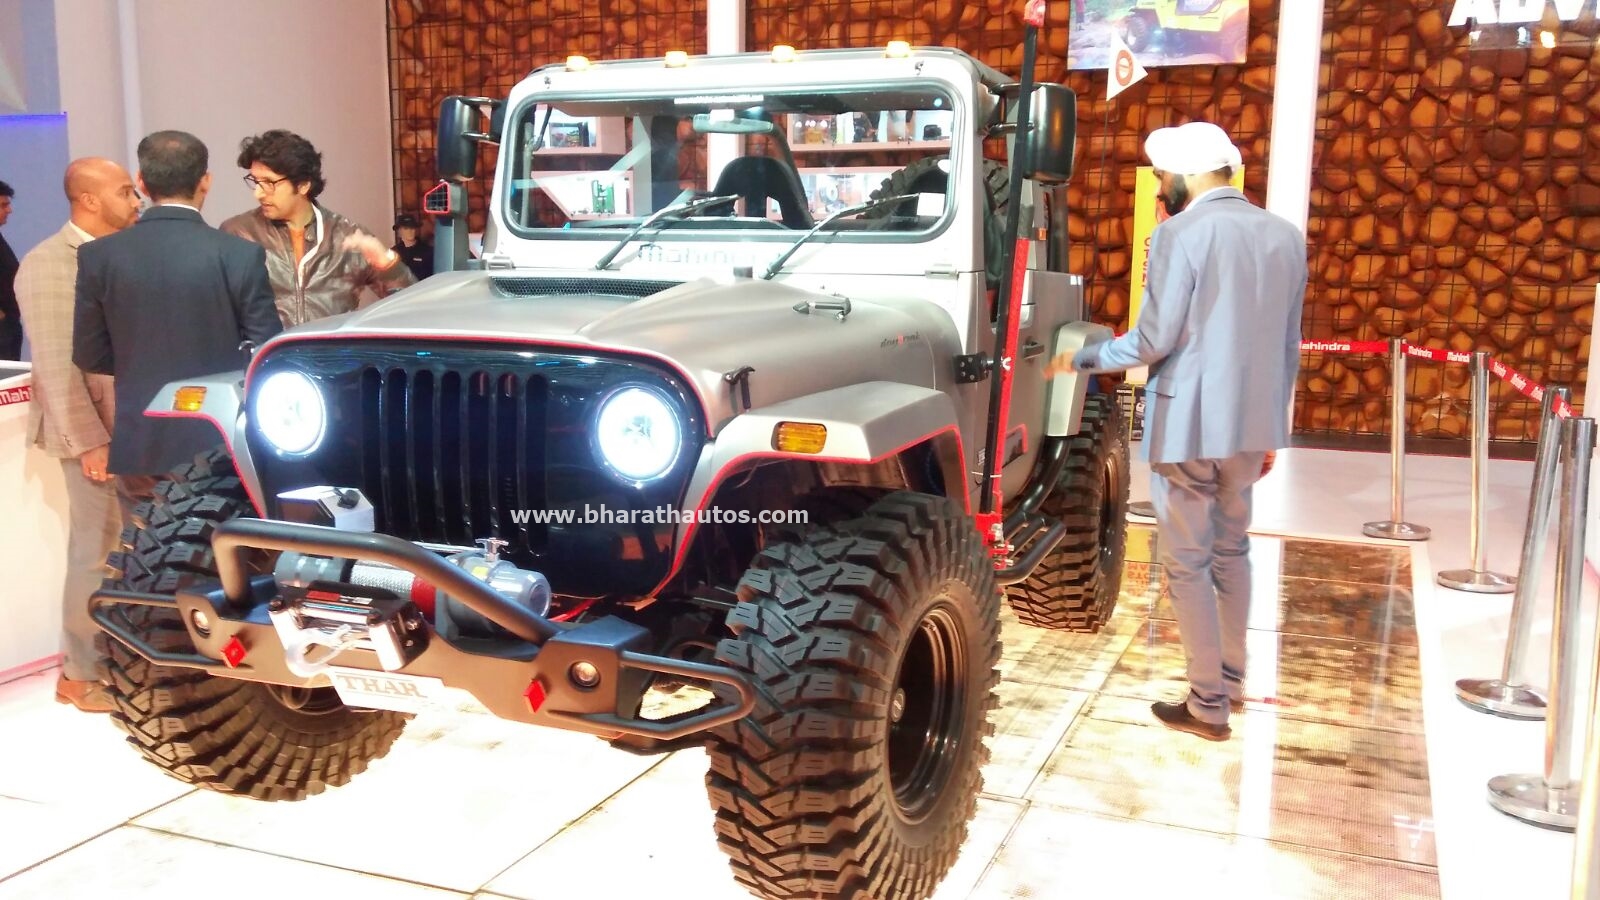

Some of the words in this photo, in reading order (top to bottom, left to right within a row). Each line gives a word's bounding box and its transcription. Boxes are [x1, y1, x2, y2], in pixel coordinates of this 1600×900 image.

[1448, 0, 1600, 26] ADV
[1299, 341, 1350, 351] ahindra
[336, 674, 428, 699] THAR
